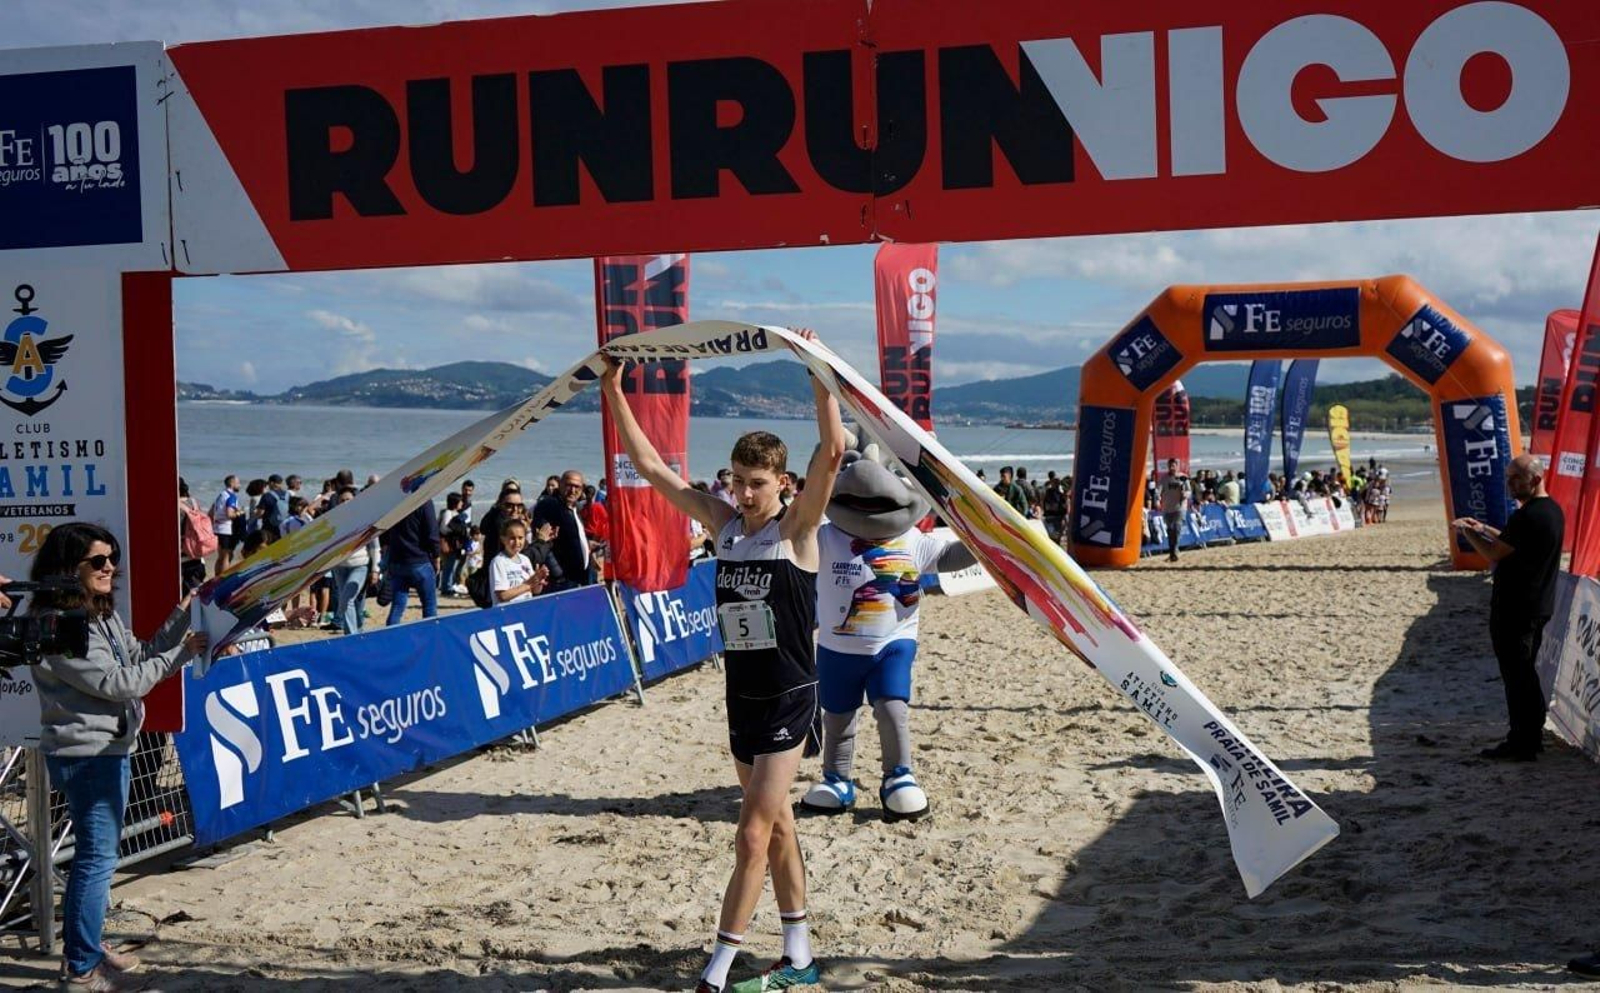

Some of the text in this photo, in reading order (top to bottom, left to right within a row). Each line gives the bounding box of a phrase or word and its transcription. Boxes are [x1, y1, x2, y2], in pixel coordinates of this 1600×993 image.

[48, 121, 120, 164] 100
[1244, 303, 1350, 334] FE seguros
[1130, 334, 1157, 358] FE
[1421, 329, 1451, 358] FE
[16, 423, 51, 434] CLUB
[1081, 411, 1117, 512] FE seguros
[1464, 436, 1499, 478] FE
[653, 590, 689, 643] FE
[739, 618, 749, 637] 5
[501, 622, 616, 690] FE seguros
[265, 668, 446, 763] FE seguros
[1120, 679, 1172, 729] SAMIL
[1127, 671, 1178, 720] ATLETISMO
[1203, 721, 1290, 826] PRAIA DE SAMIL
